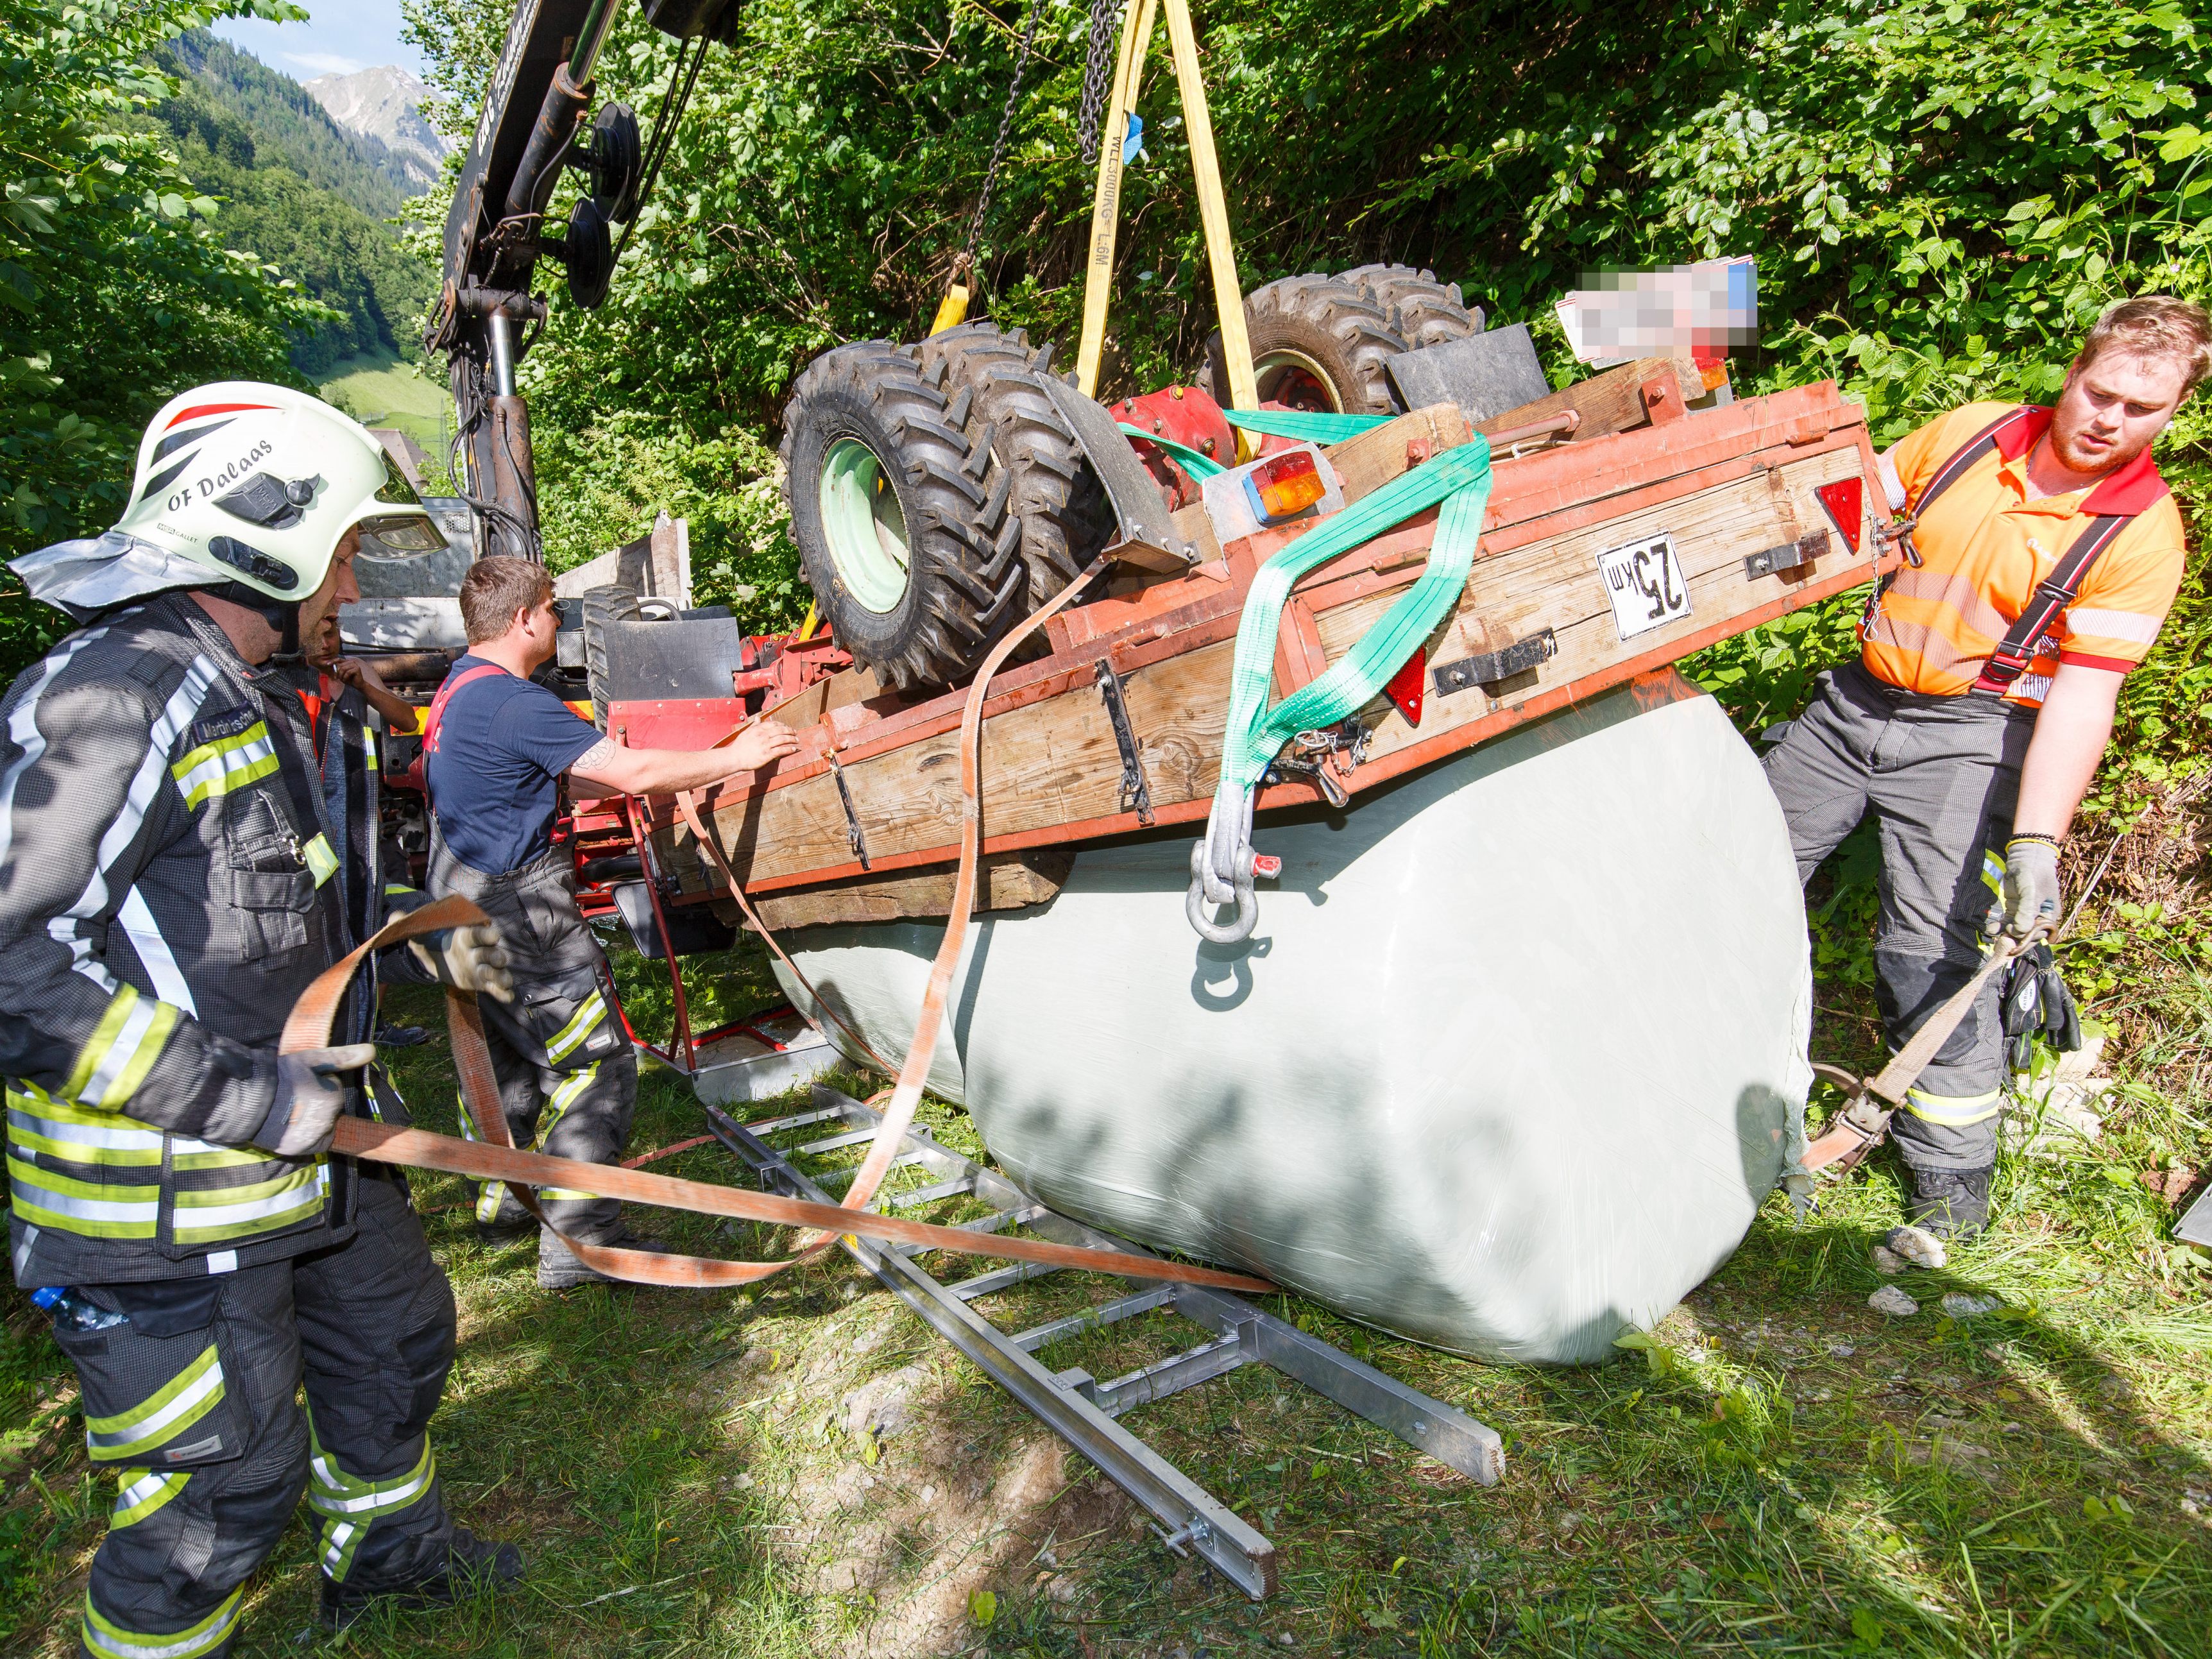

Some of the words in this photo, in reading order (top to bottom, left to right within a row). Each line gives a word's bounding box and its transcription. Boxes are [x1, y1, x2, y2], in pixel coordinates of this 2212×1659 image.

[168, 488, 192, 512] OF
[197, 439, 272, 497] Dalaas
[175, 531, 198, 543] GALLET
